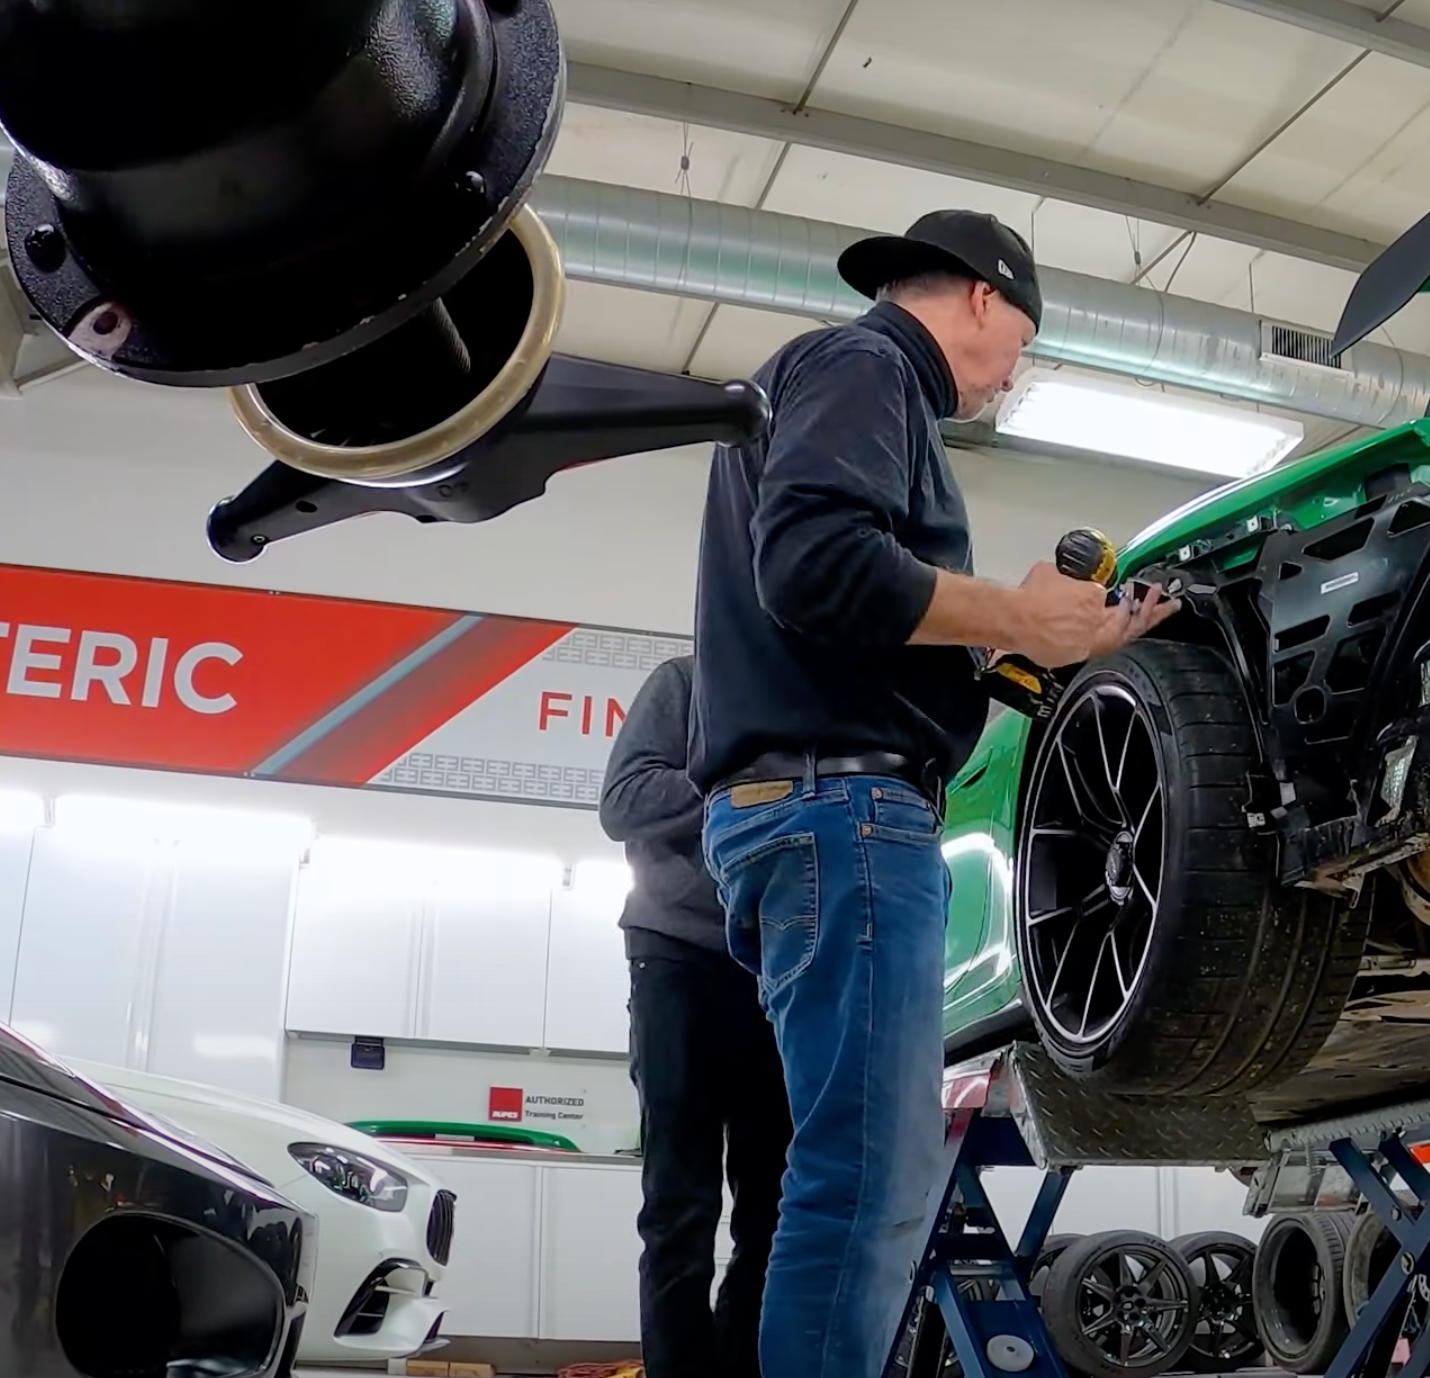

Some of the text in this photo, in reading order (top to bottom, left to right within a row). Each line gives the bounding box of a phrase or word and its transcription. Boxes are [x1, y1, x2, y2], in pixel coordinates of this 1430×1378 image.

[0, 621, 244, 714] ERIC
[525, 1095, 585, 1106] AUTHORIZED
[525, 1110, 584, 1120] Training Center
